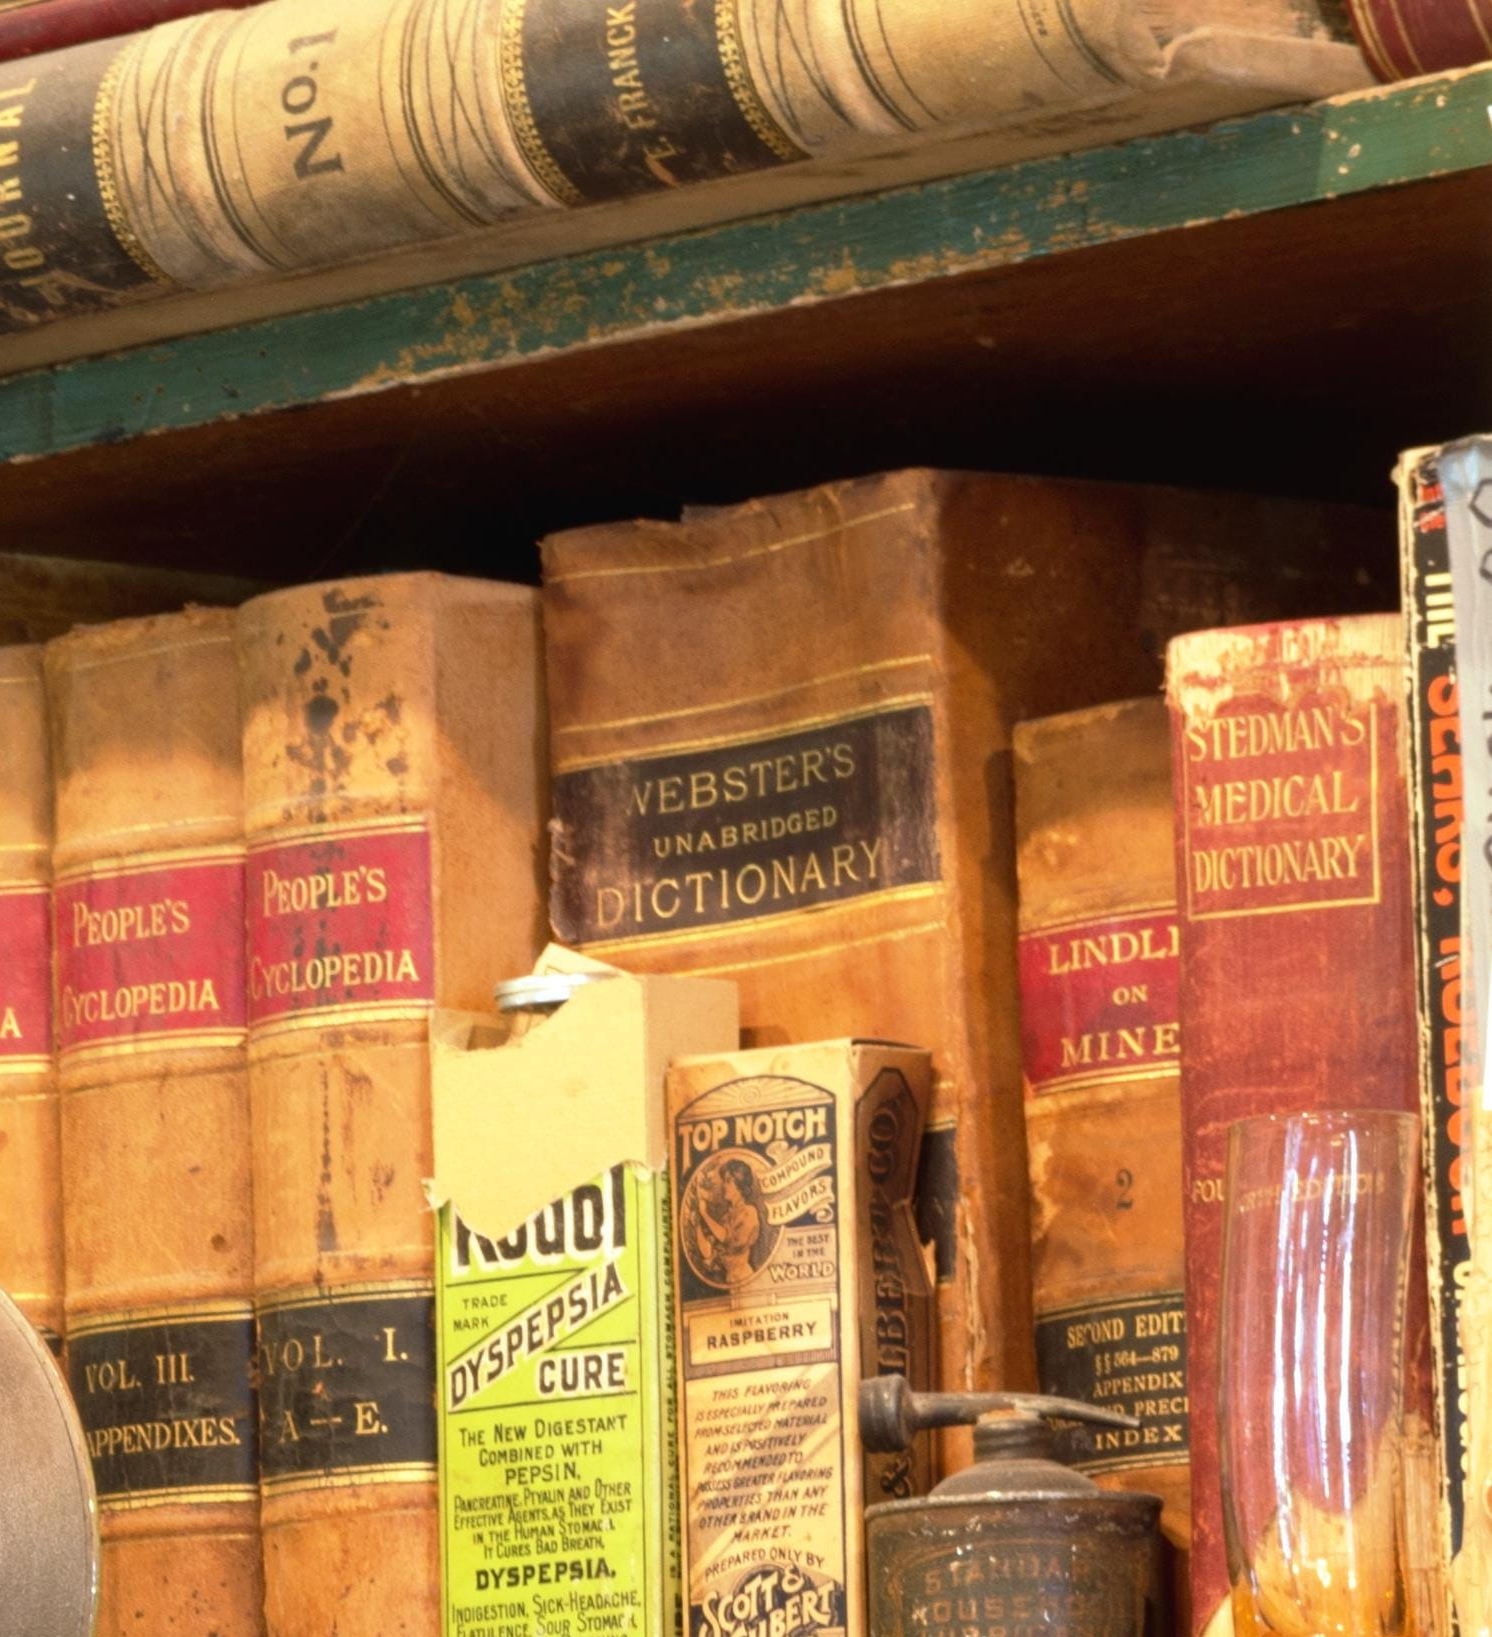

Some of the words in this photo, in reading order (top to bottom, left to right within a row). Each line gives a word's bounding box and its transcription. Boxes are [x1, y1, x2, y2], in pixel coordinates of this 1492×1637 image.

[604, 5, 654, 131] FRANCK
[1186, 706, 1366, 763] STEDMAN'S
[625, 744, 856, 817] WEBSTER'S
[1195, 771, 1359, 828] MEDICAL
[653, 805, 838, 859] UNABRIDGED
[596, 838, 884, 929] DICTIONARY
[1192, 834, 1367, 894] DICTIONARY
[263, 865, 388, 917] PEOPLE'S
[73, 899, 191, 948] PEOPLE'S
[249, 948, 420, 1000] CYCLOPEDIA
[62, 979, 220, 1029] CYCLOPEDIA
[1112, 984, 1148, 1006] ON
[678, 1117, 728, 1175] TOP
[735, 1107, 827, 1145] NOTCH
[761, 1147, 825, 1189] COMPOUND
[771, 1181, 828, 1220] FLAVORS
[806, 1233, 830, 1246] BEST
[768, 1262, 835, 1283] WORLD
[462, 1294, 507, 1310] TRADE
[729, 1312, 789, 1327] IMITATION
[450, 1260, 624, 1409] DYSPEPSIA
[453, 1318, 490, 1332] MARK
[707, 1321, 817, 1350] RASPBERRY
[1136, 1312, 1186, 1342] EDIT
[85, 1359, 142, 1394] VOL.
[155, 1353, 195, 1385] III.
[264, 1335, 343, 1377] VOL.
[538, 1353, 625, 1394] CURE
[1093, 1371, 1184, 1398] APPENDIX
[279, 1409, 300, 1444] A
[354, 1402, 389, 1436] E.
[459, 1428, 485, 1447] THE
[494, 1424, 527, 1442] NEW
[534, 1414, 627, 1438] DIGESTANT
[1094, 1424, 1182, 1450] INDEX
[479, 1445, 554, 1467] COMBINED
[561, 1440, 603, 1457] WITH
[523, 1487, 564, 1505] PTYALIN
[568, 1486, 590, 1500] AND
[594, 1478, 631, 1497] OTHER
[454, 1513, 504, 1531] EFFECTIVE
[552, 1508, 565, 1519] AS
[568, 1502, 595, 1517] THEY
[600, 1499, 633, 1515] EXIST
[473, 1532, 483, 1545] IN
[488, 1529, 510, 1543] THE
[514, 1522, 554, 1541] HUMAN
[496, 1543, 531, 1559] CURES
[536, 1539, 558, 1555] BAD
[705, 1549, 765, 1580] PREPARED
[770, 1547, 801, 1562] ONLY
[806, 1554, 825, 1569] BY
[536, 1614, 571, 1636] SOUR
